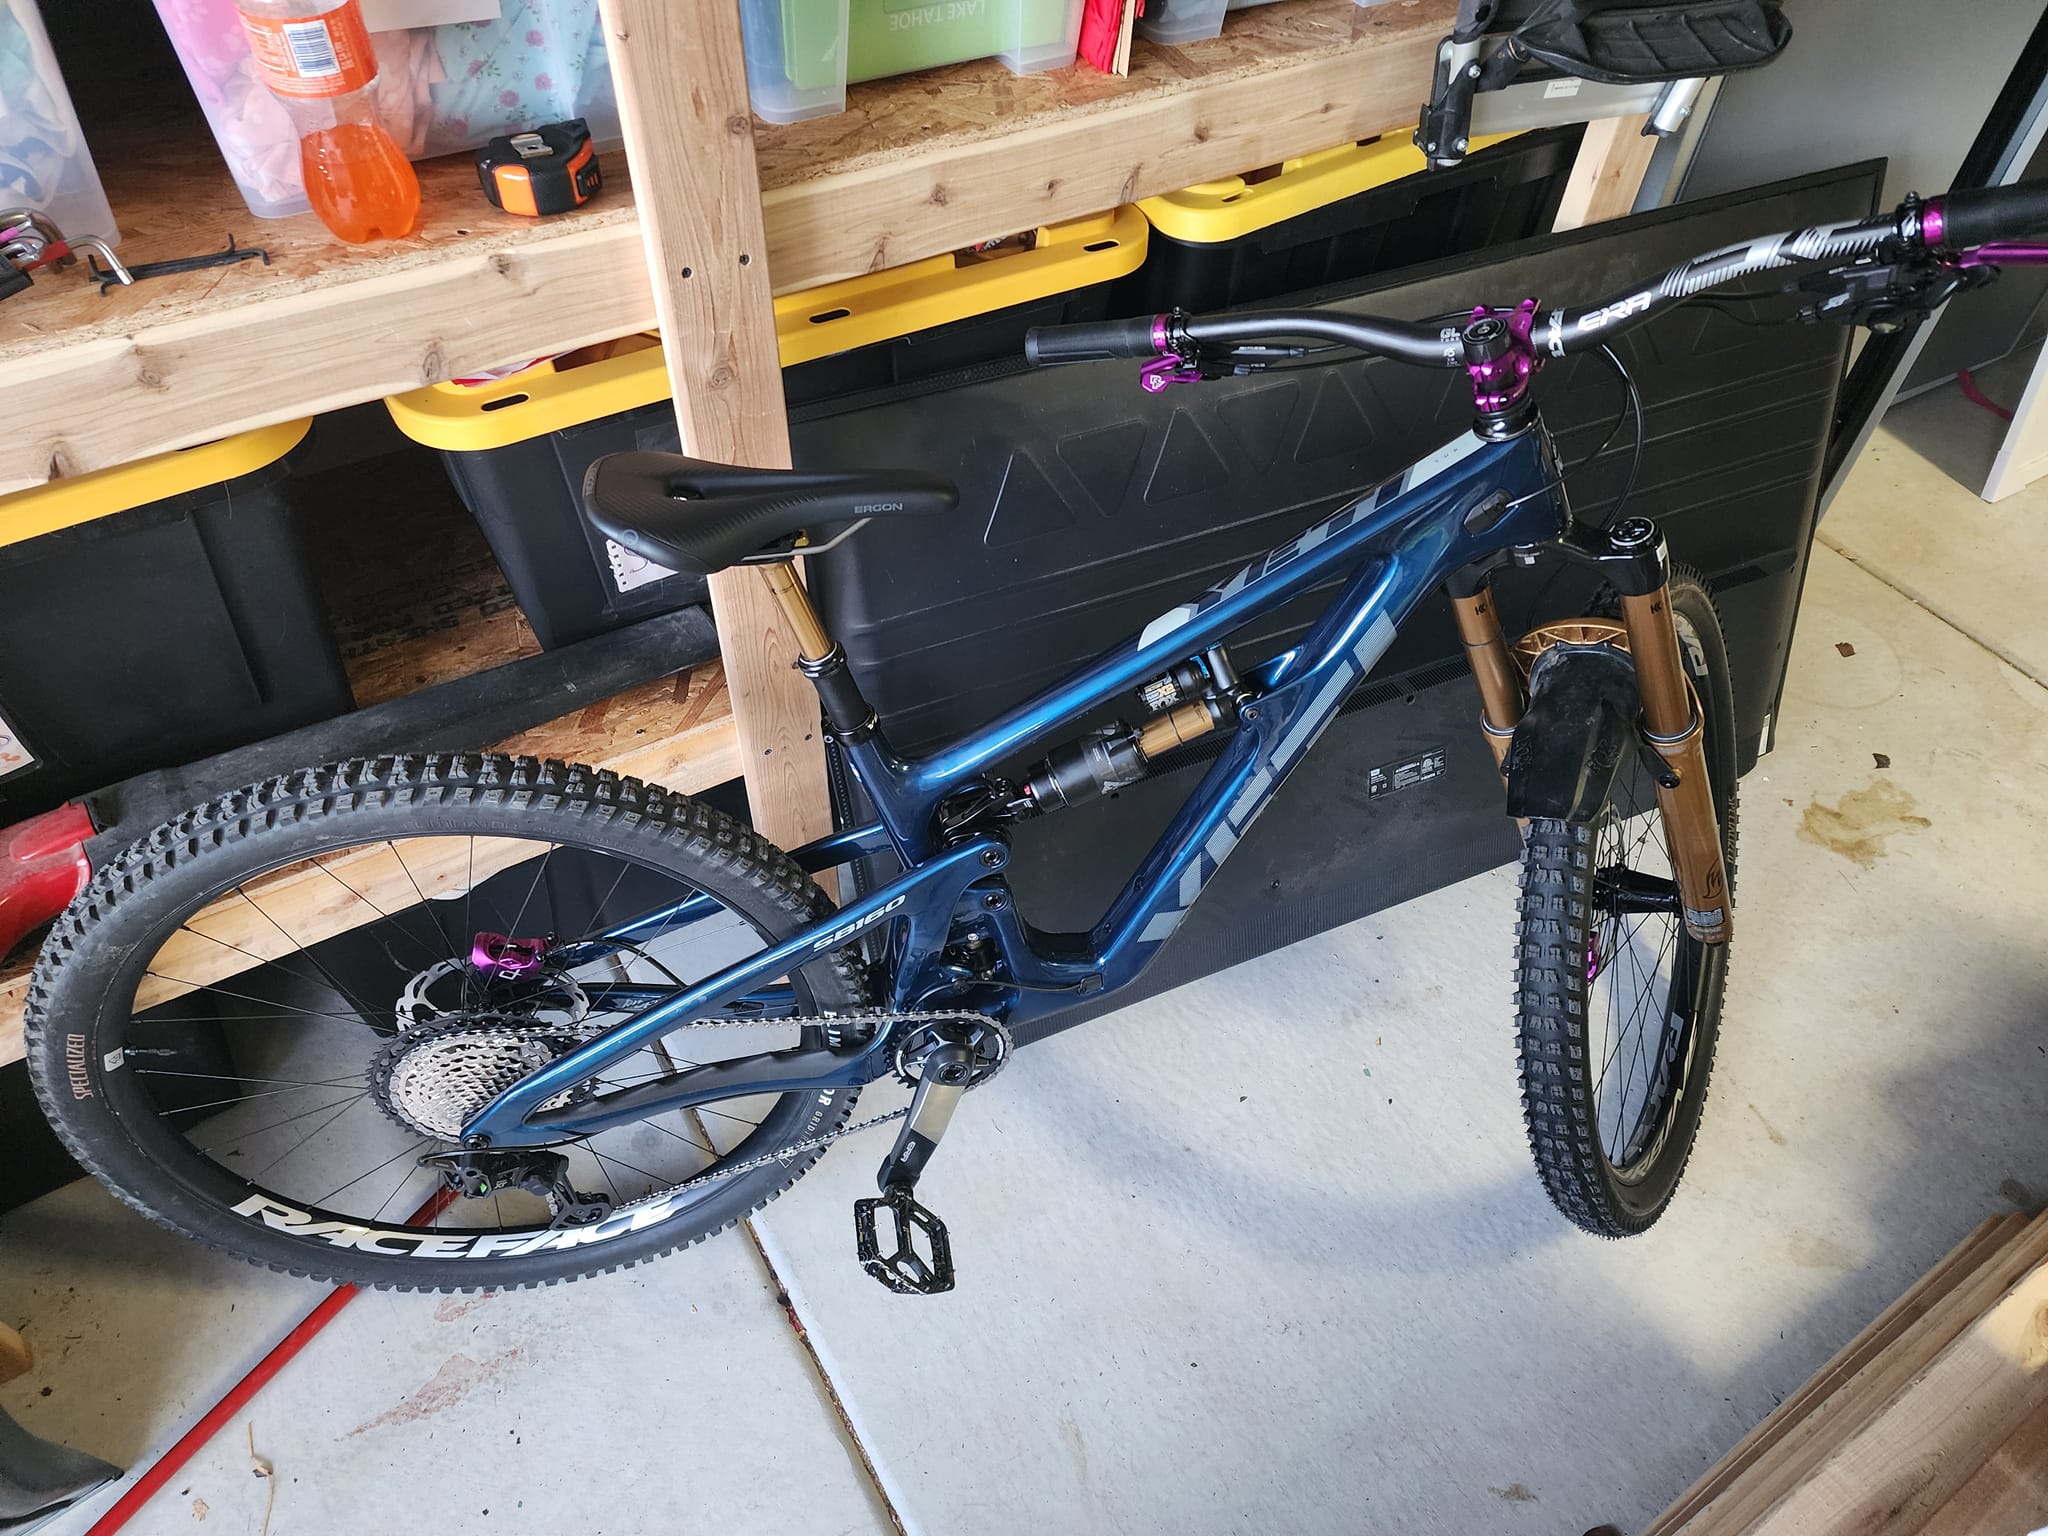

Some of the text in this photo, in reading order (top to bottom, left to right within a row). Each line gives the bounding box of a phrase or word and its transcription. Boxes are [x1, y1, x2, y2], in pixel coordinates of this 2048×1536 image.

[889, 0, 985, 32] LAKE TAHOE
[1577, 290, 1653, 332] ERA
[854, 502, 904, 514] ERGON
[1150, 691, 1179, 712] FOX
[813, 894, 906, 953] SB160
[66, 1033, 94, 1100] SPECIALIZED
[230, 1194, 680, 1259] RACEFACE
